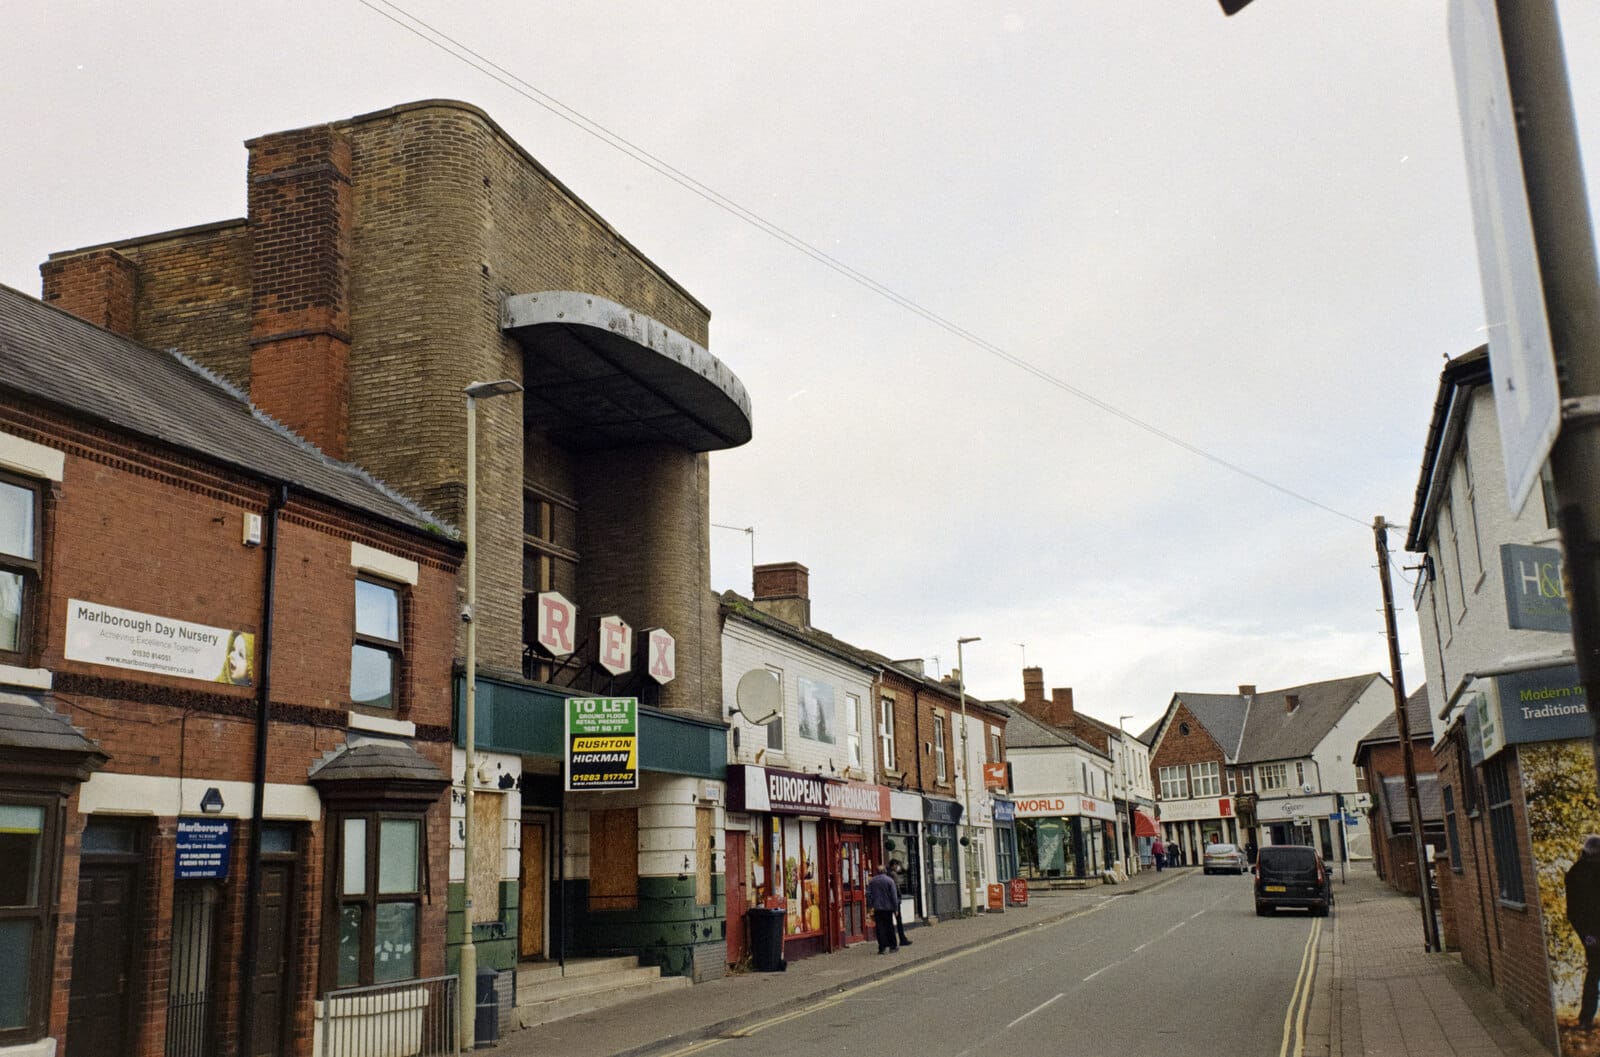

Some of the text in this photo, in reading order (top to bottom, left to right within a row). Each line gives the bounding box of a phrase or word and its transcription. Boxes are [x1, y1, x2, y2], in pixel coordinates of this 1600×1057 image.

[78, 607, 219, 646] Marlborough Day Nursery
[1520, 687, 1571, 702] Modern
[573, 700, 631, 713] TO LET
[1520, 703, 1588, 719] Traditiona
[577, 740, 632, 749] RUSHTON
[573, 753, 628, 763] HICKMAN
[769, 774, 823, 805] EUROPEAN
[824, 783, 880, 812] SUPERMARKET
[1016, 799, 1065, 812] WORLD
[178, 822, 228, 835] Marlborough
